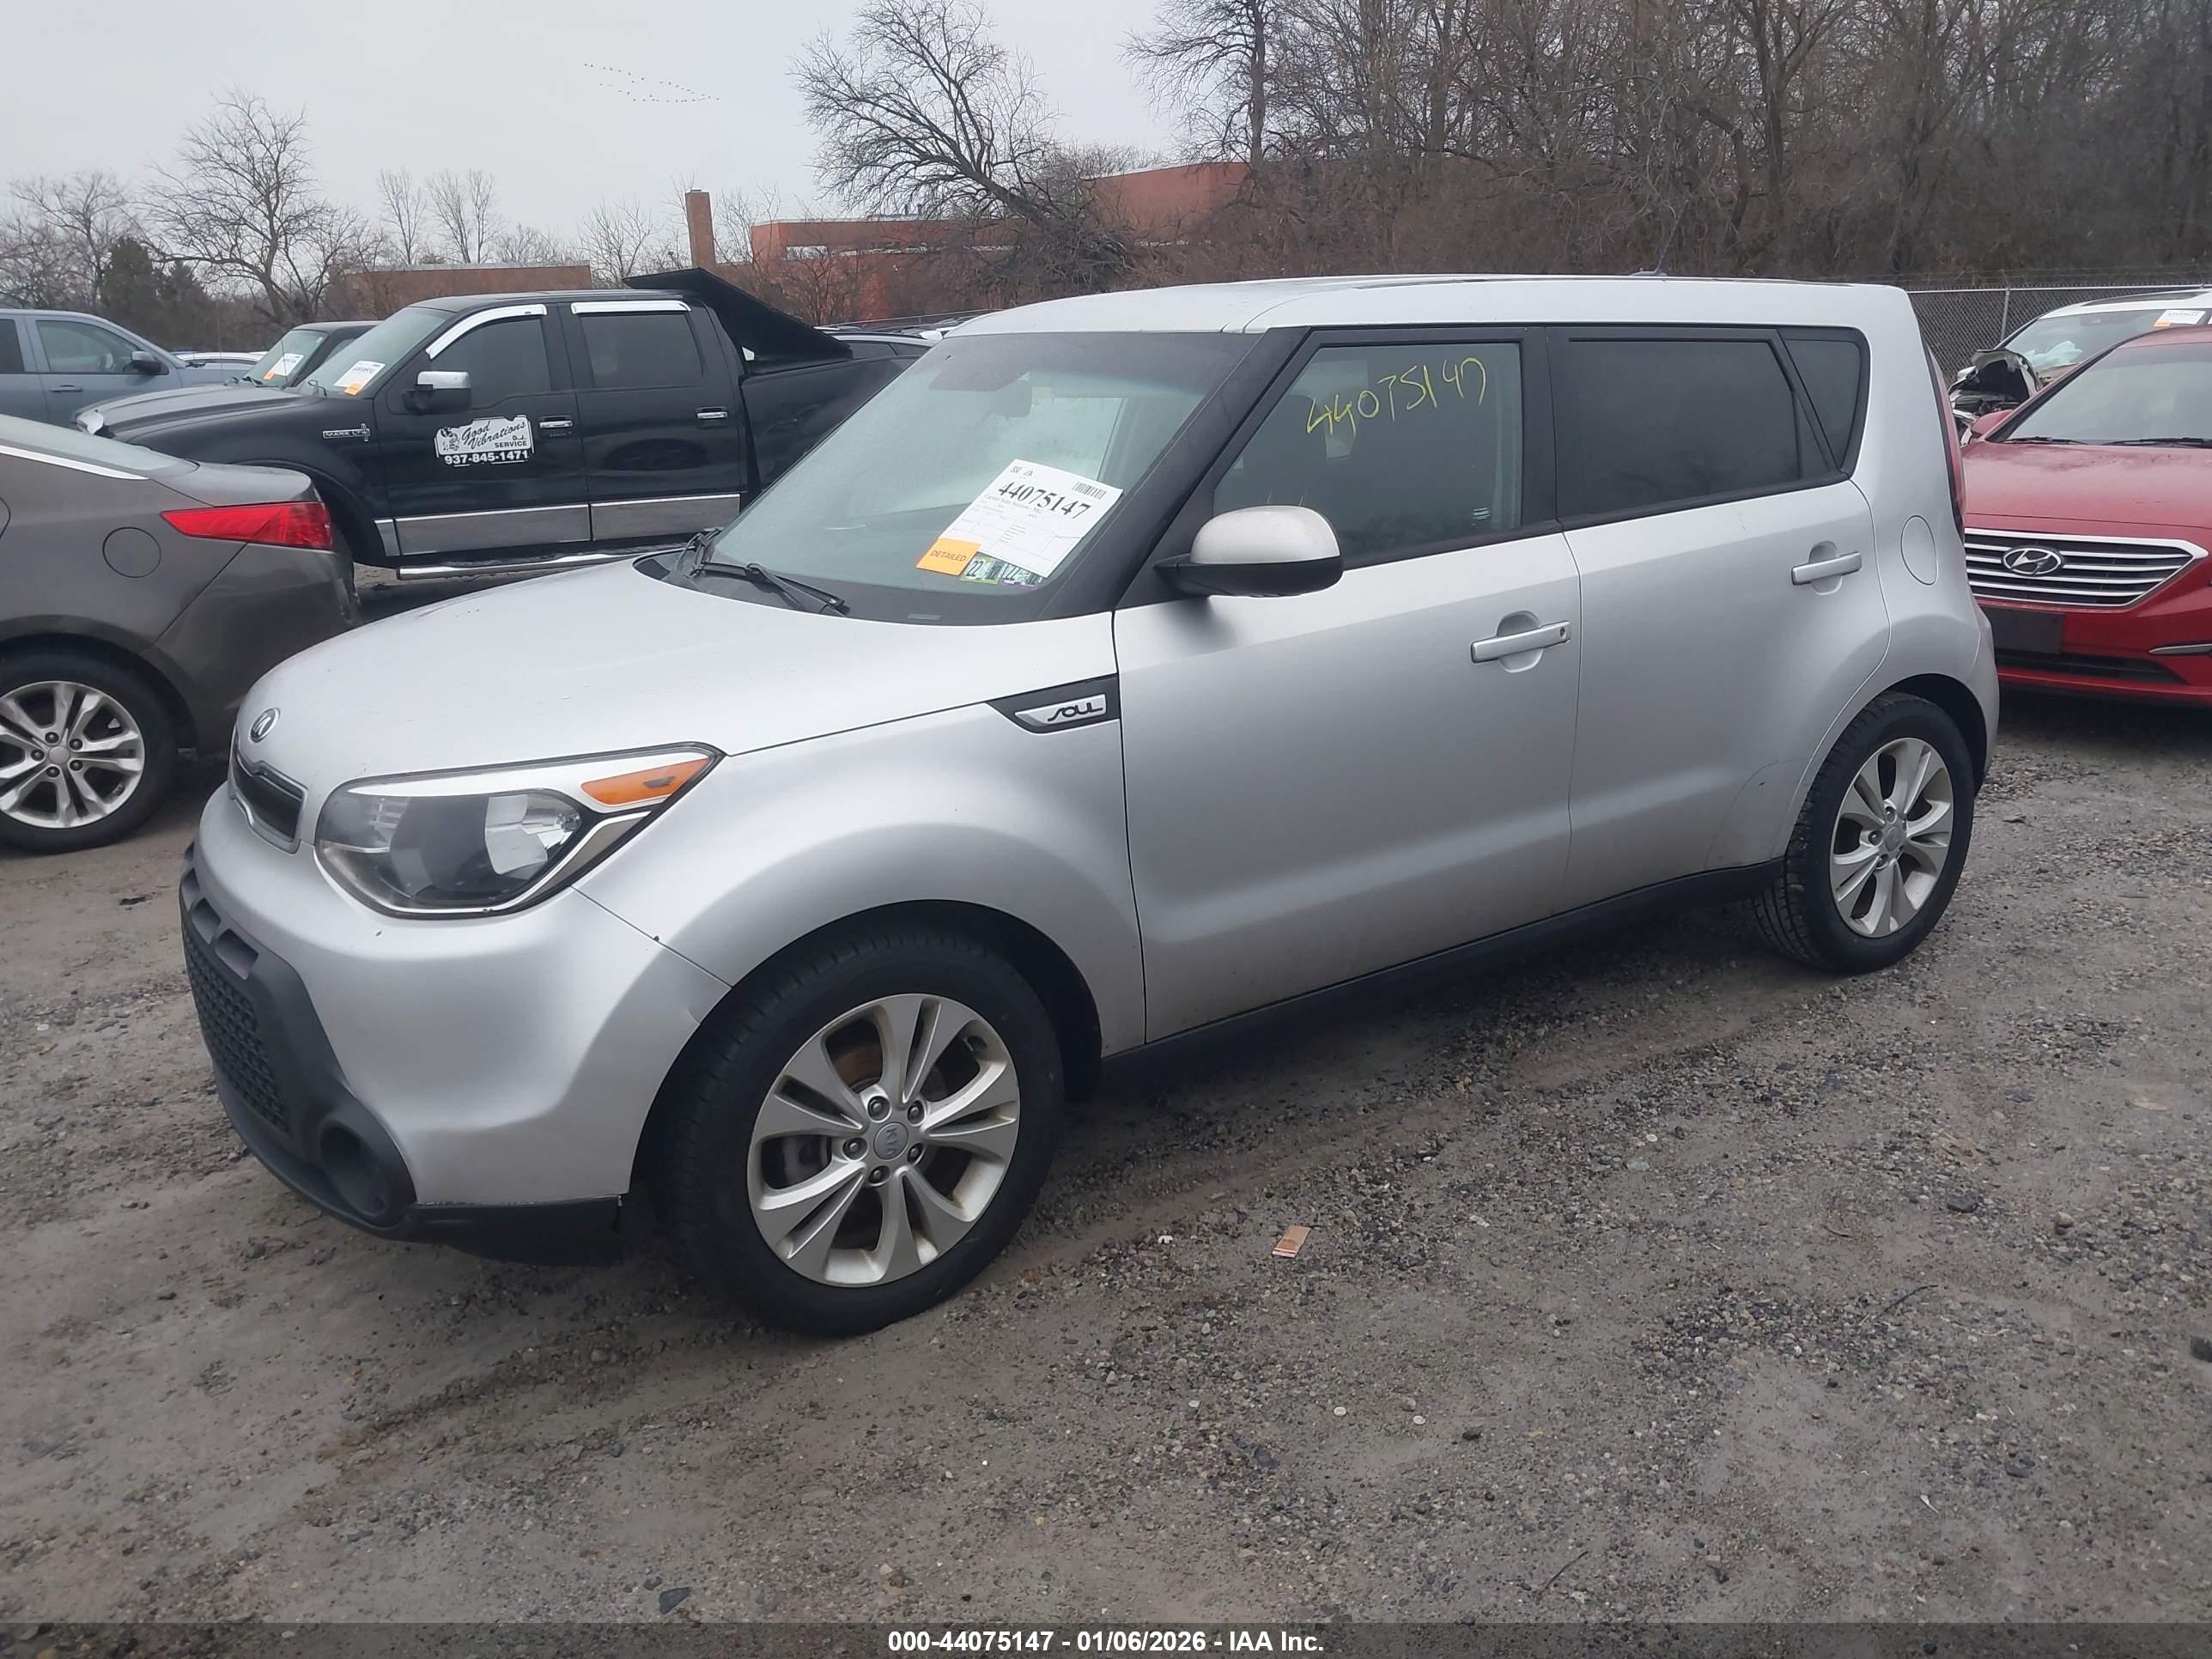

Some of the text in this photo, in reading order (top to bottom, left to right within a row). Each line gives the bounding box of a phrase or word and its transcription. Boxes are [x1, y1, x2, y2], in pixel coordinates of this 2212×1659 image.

[1306, 357, 1486, 439] 44075147
[461, 421, 491, 443] Good
[465, 422, 526, 449] Vibrations
[444, 449, 529, 465] 937-845-1471
[999, 482, 1091, 519] 44075147
[930, 549, 966, 562] DETAILED
